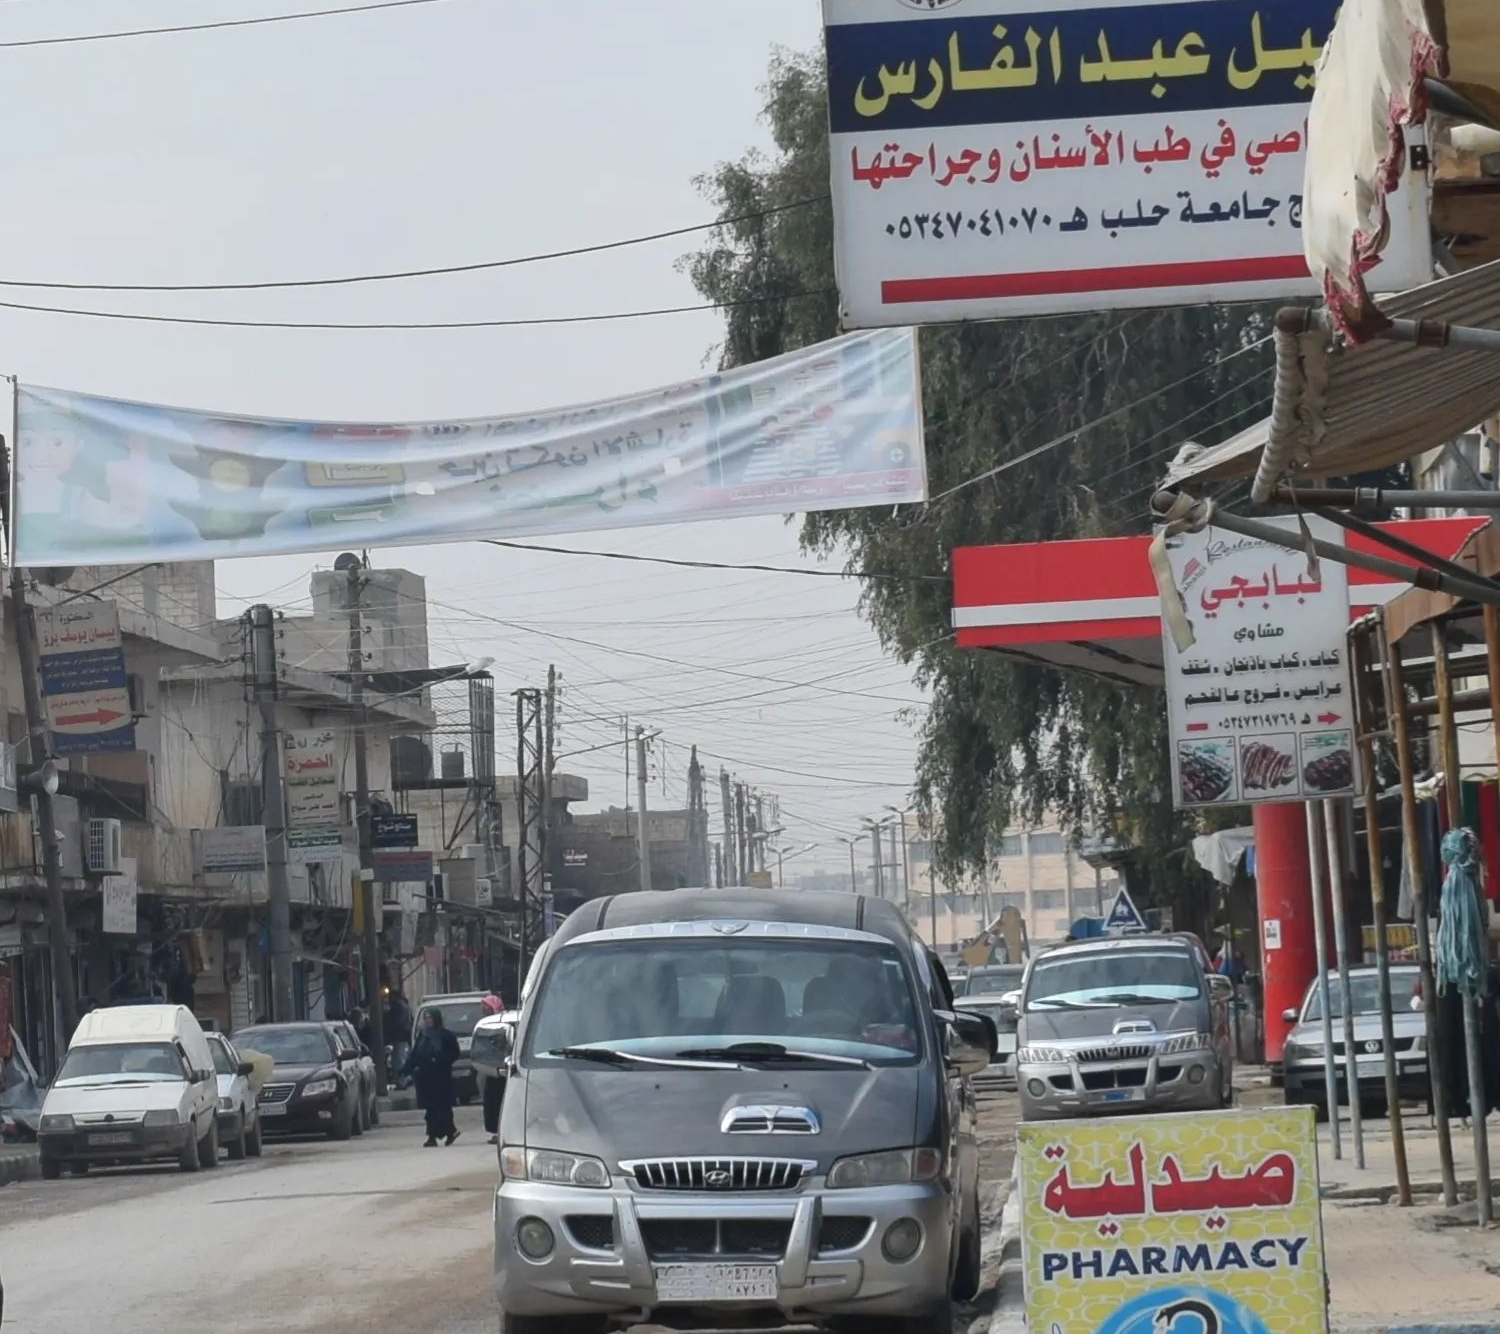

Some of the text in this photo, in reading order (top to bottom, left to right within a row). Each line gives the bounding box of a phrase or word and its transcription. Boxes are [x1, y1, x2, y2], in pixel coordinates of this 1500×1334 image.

[854, 24, 1060, 116] الفارس
[1081, 24, 1210, 98] عبد
[850, 143, 999, 189] وجراحتها
[1009, 124, 1124, 183] الأسنان
[1133, 125, 1191, 176] طب
[1200, 119, 1236, 179] في
[1101, 201, 1171, 239] حلب
[1179, 190, 1281, 222] جامعة
[1233, 622, 1285, 644] مشاوي
[1181, 648, 1340, 676] كباب كباب باذنجان شقف
[1243, 682, 1280, 705] فروج
[288, 753, 334, 774] الحمزة
[1044, 1141, 1296, 1237] صيدلية
[1043, 1236, 1308, 1281] PHARMACY
